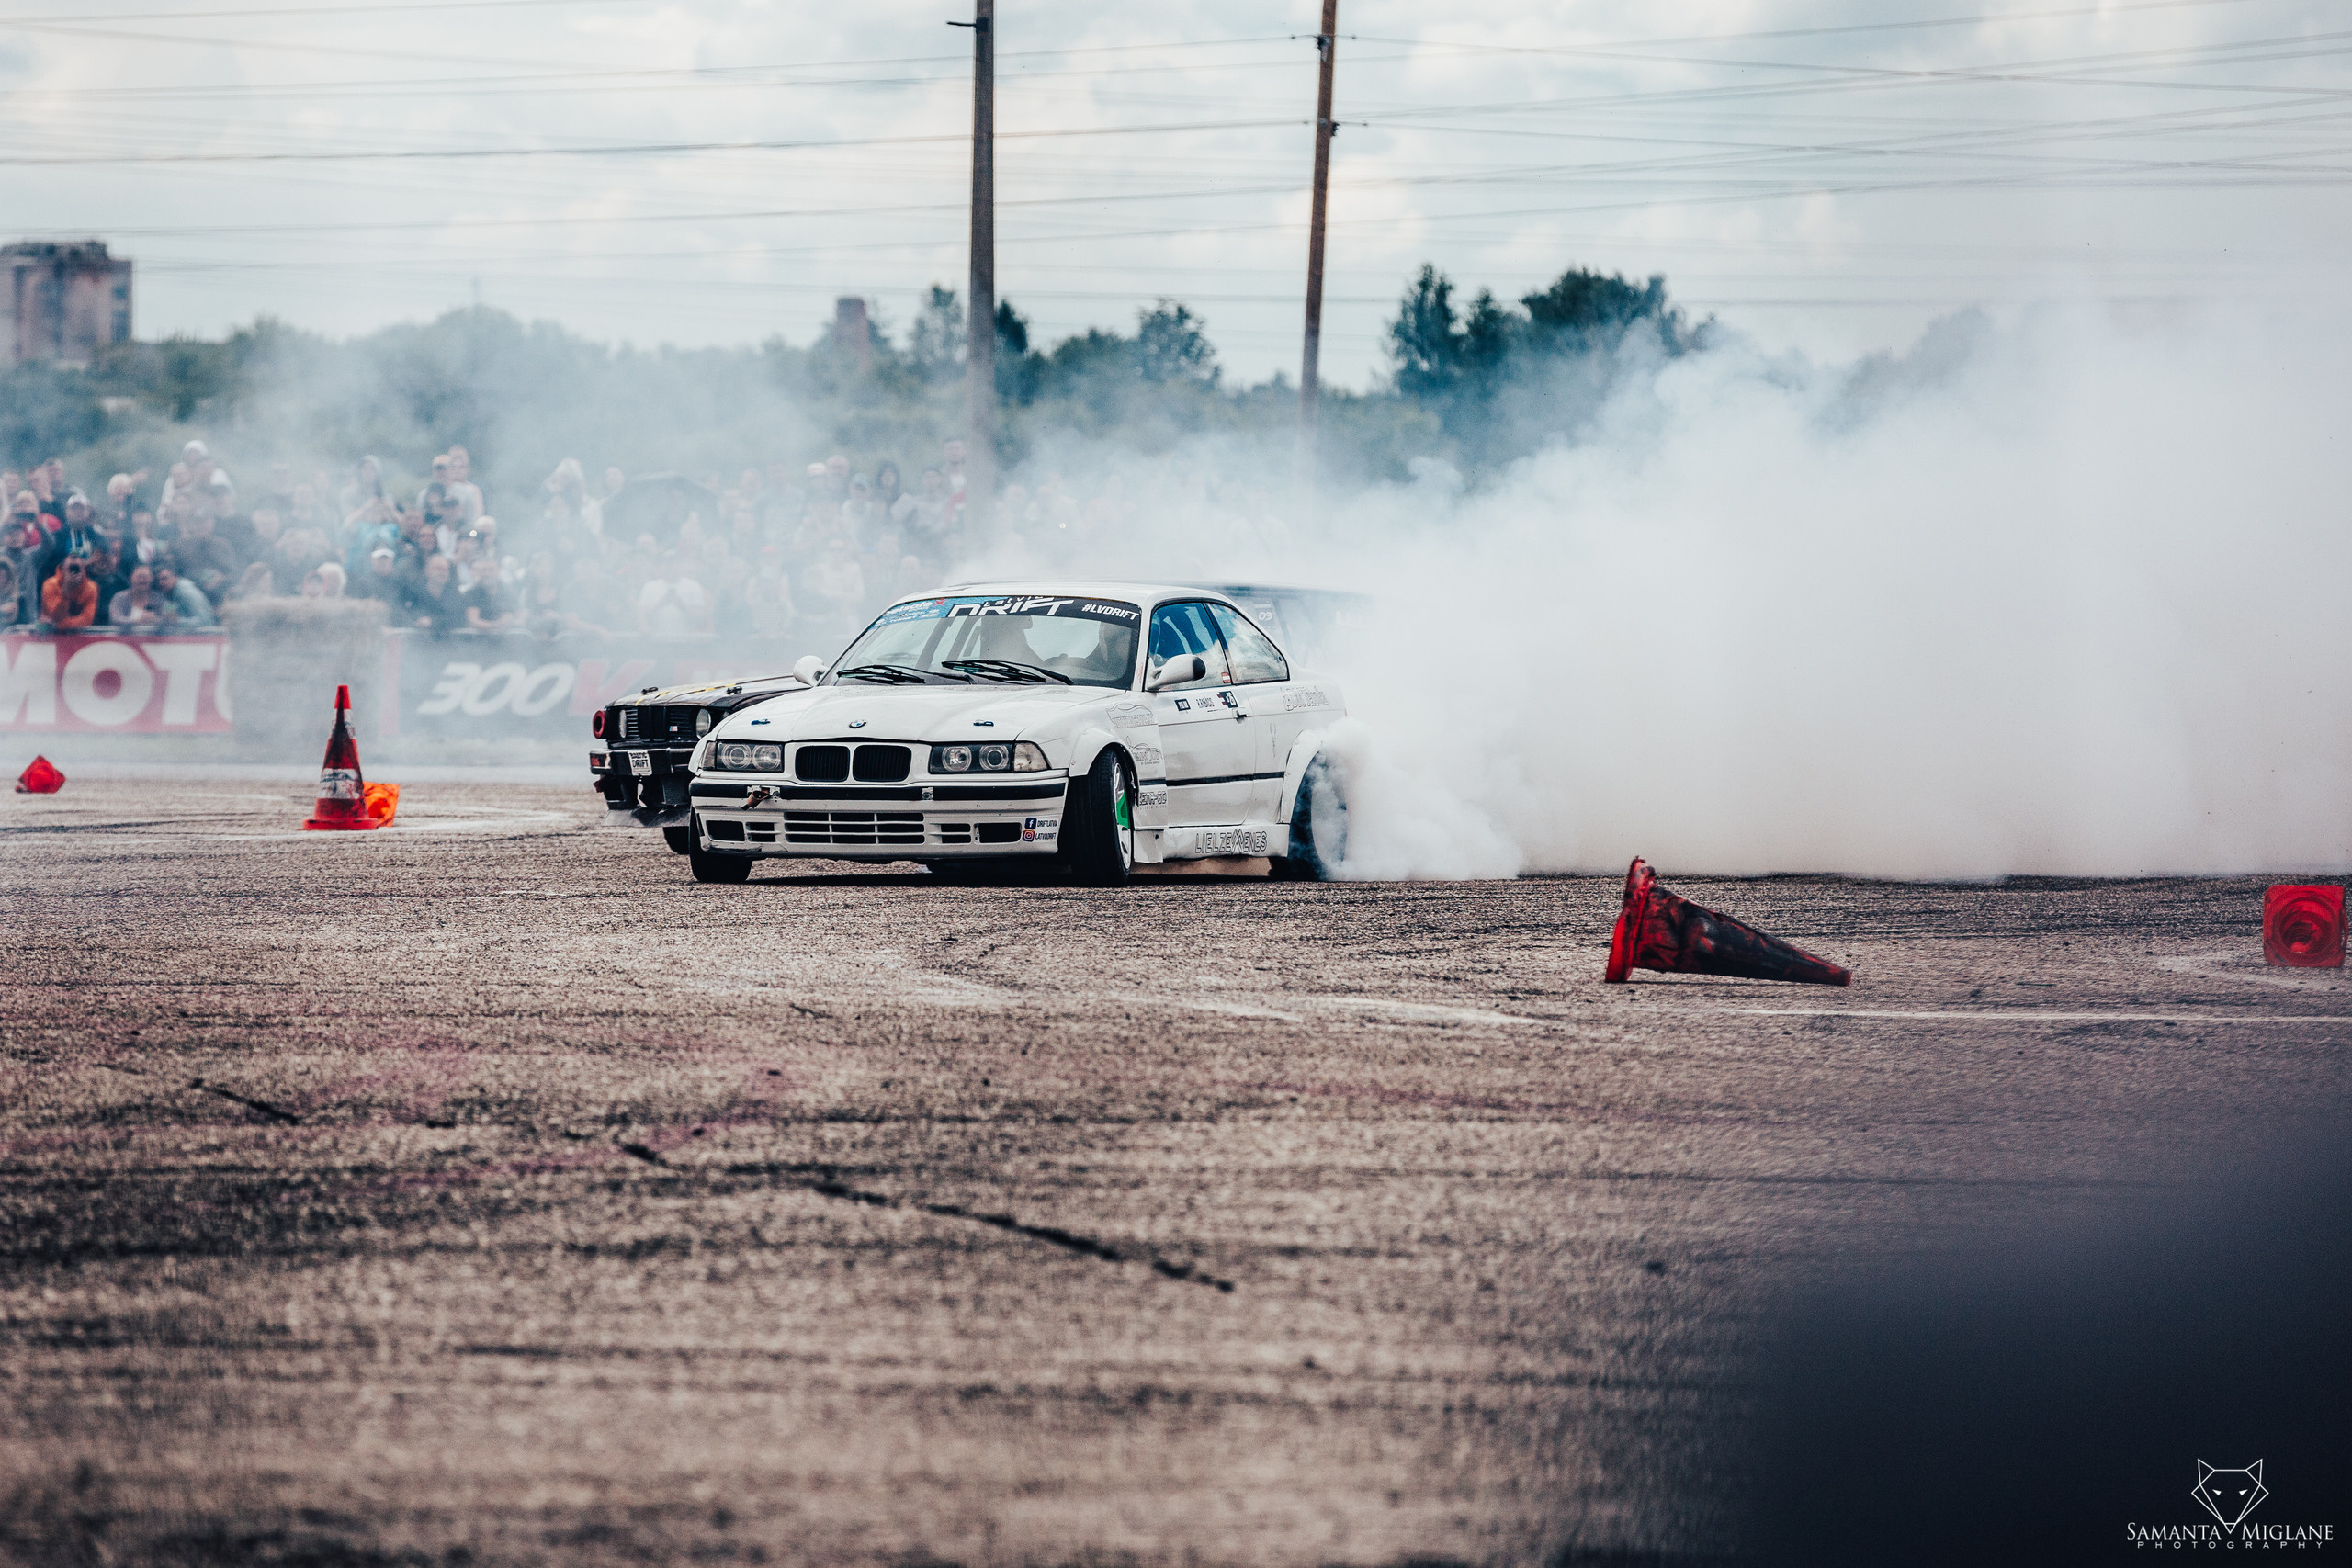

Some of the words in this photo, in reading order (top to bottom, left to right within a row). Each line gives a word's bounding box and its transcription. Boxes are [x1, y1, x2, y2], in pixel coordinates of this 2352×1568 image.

[947, 597, 1074, 618] DRIFT
[1081, 603, 1139, 621] #LVDRIFT
[1258, 611, 1272, 621] 03
[632, 759, 649, 768] DRIFT
